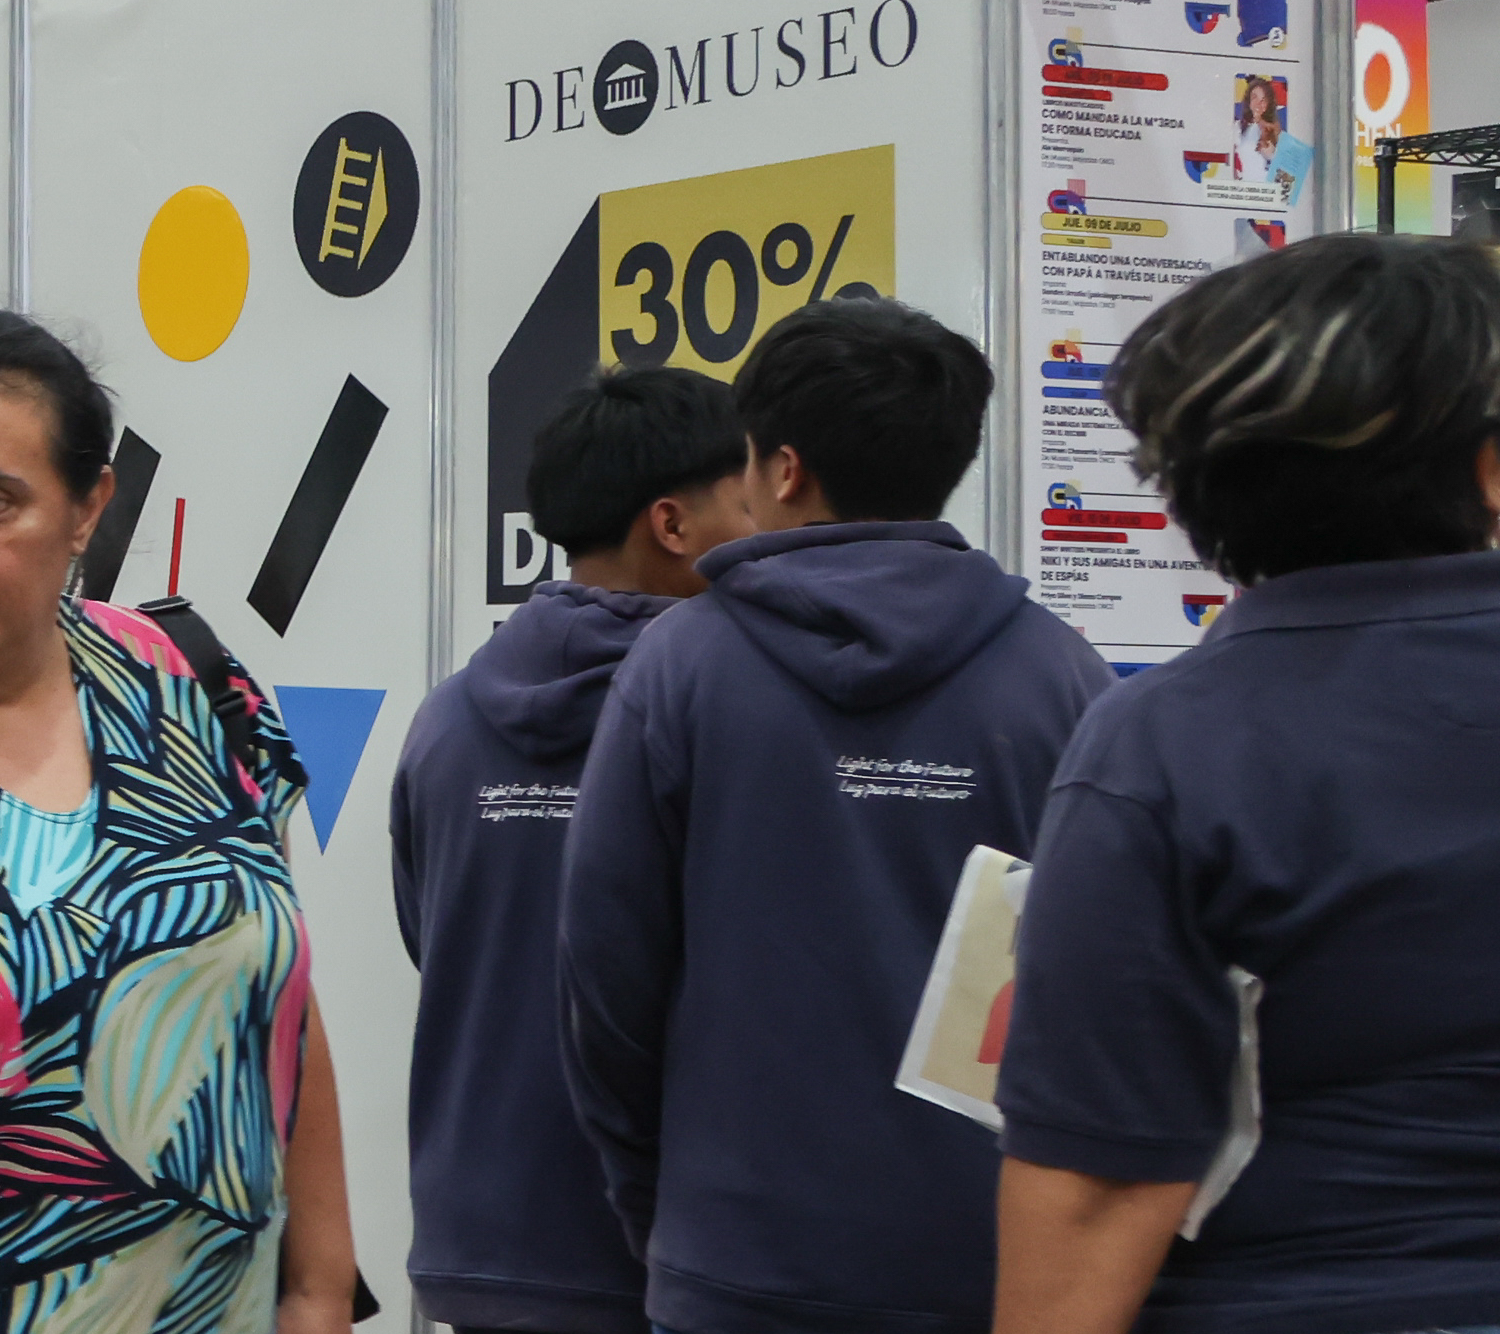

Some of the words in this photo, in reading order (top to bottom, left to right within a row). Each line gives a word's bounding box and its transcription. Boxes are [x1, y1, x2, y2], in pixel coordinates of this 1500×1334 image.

[504, 65, 587, 143] DE
[1042, 109, 1074, 121] COMO
[1075, 111, 1120, 125] MANDAR
[1122, 114, 1130, 124] A
[1131, 115, 1143, 126] LA
[1042, 123, 1055, 134] DE
[1056, 124, 1091, 138] FORMA
[1094, 127, 1142, 141] EDUCADA
[1062, 218, 1082, 229] JUE.
[1084, 219, 1098, 230] 09
[1100, 220, 1111, 231] DE
[1113, 221, 1141, 233] JULIO
[1042, 250, 1108, 265] ENTABLANDO
[1110, 254, 1131, 266] UNA
[1042, 266, 1065, 277] CON
[1067, 265, 1093, 279] PAPÁ
[1095, 269, 1102, 279] A
[1104, 268, 1141, 282] TRAVÉS
[1143, 271, 1155, 283] DE
[1156, 273, 1169, 283] LA
[610, 214, 882, 368] 30%
[1041, 556, 1060, 567] NIKI
[1062, 557, 1069, 567] Y
[1071, 556, 1091, 568] SUS
[1093, 557, 1132, 569] AMIGAS
[1134, 557, 1147, 569] EN
[1148, 557, 1168, 569] UNA
[1041, 570, 1056, 581] DE
[1057, 569, 1089, 583] ESPÍAS
